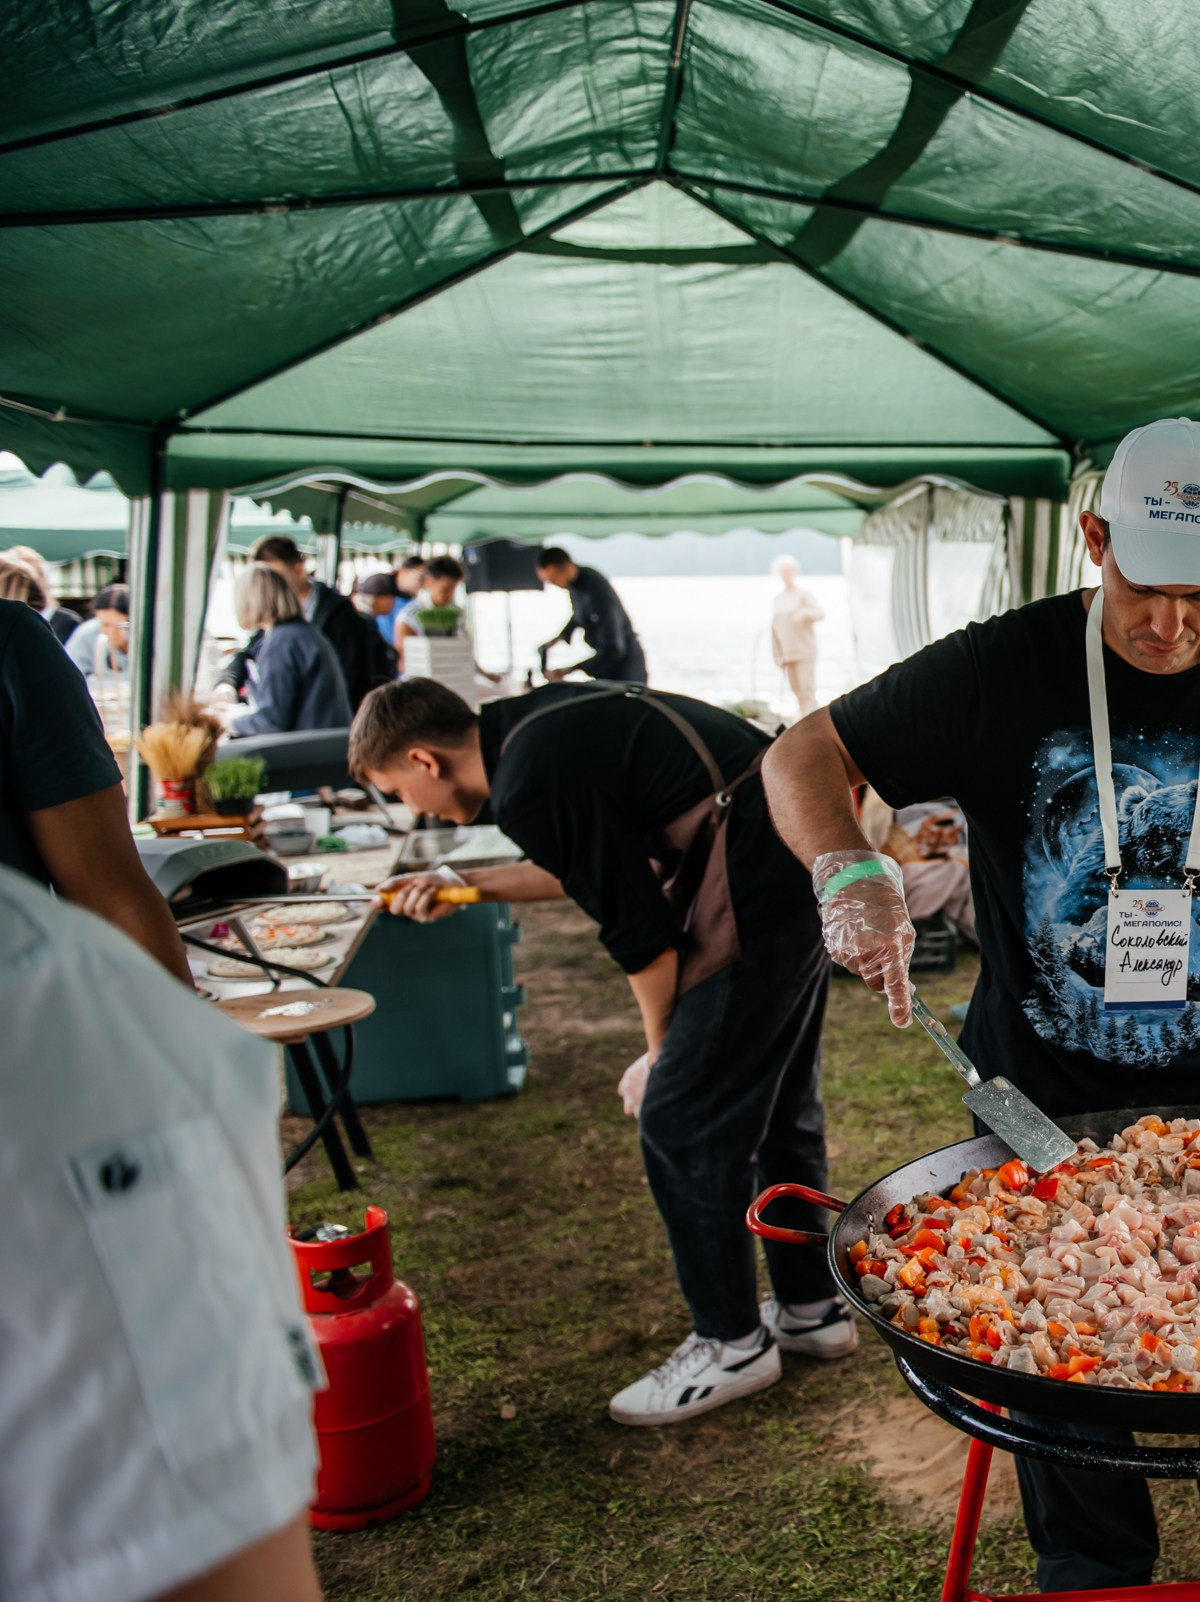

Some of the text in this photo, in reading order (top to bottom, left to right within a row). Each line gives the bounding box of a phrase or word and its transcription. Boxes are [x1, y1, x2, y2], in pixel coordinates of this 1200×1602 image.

[1163, 480, 1179, 497] 25
[1143, 496, 1162, 506] ТЫ
[1132, 899, 1144, 910] 25
[1123, 920, 1182, 928] МЕГАПОЛИС!
